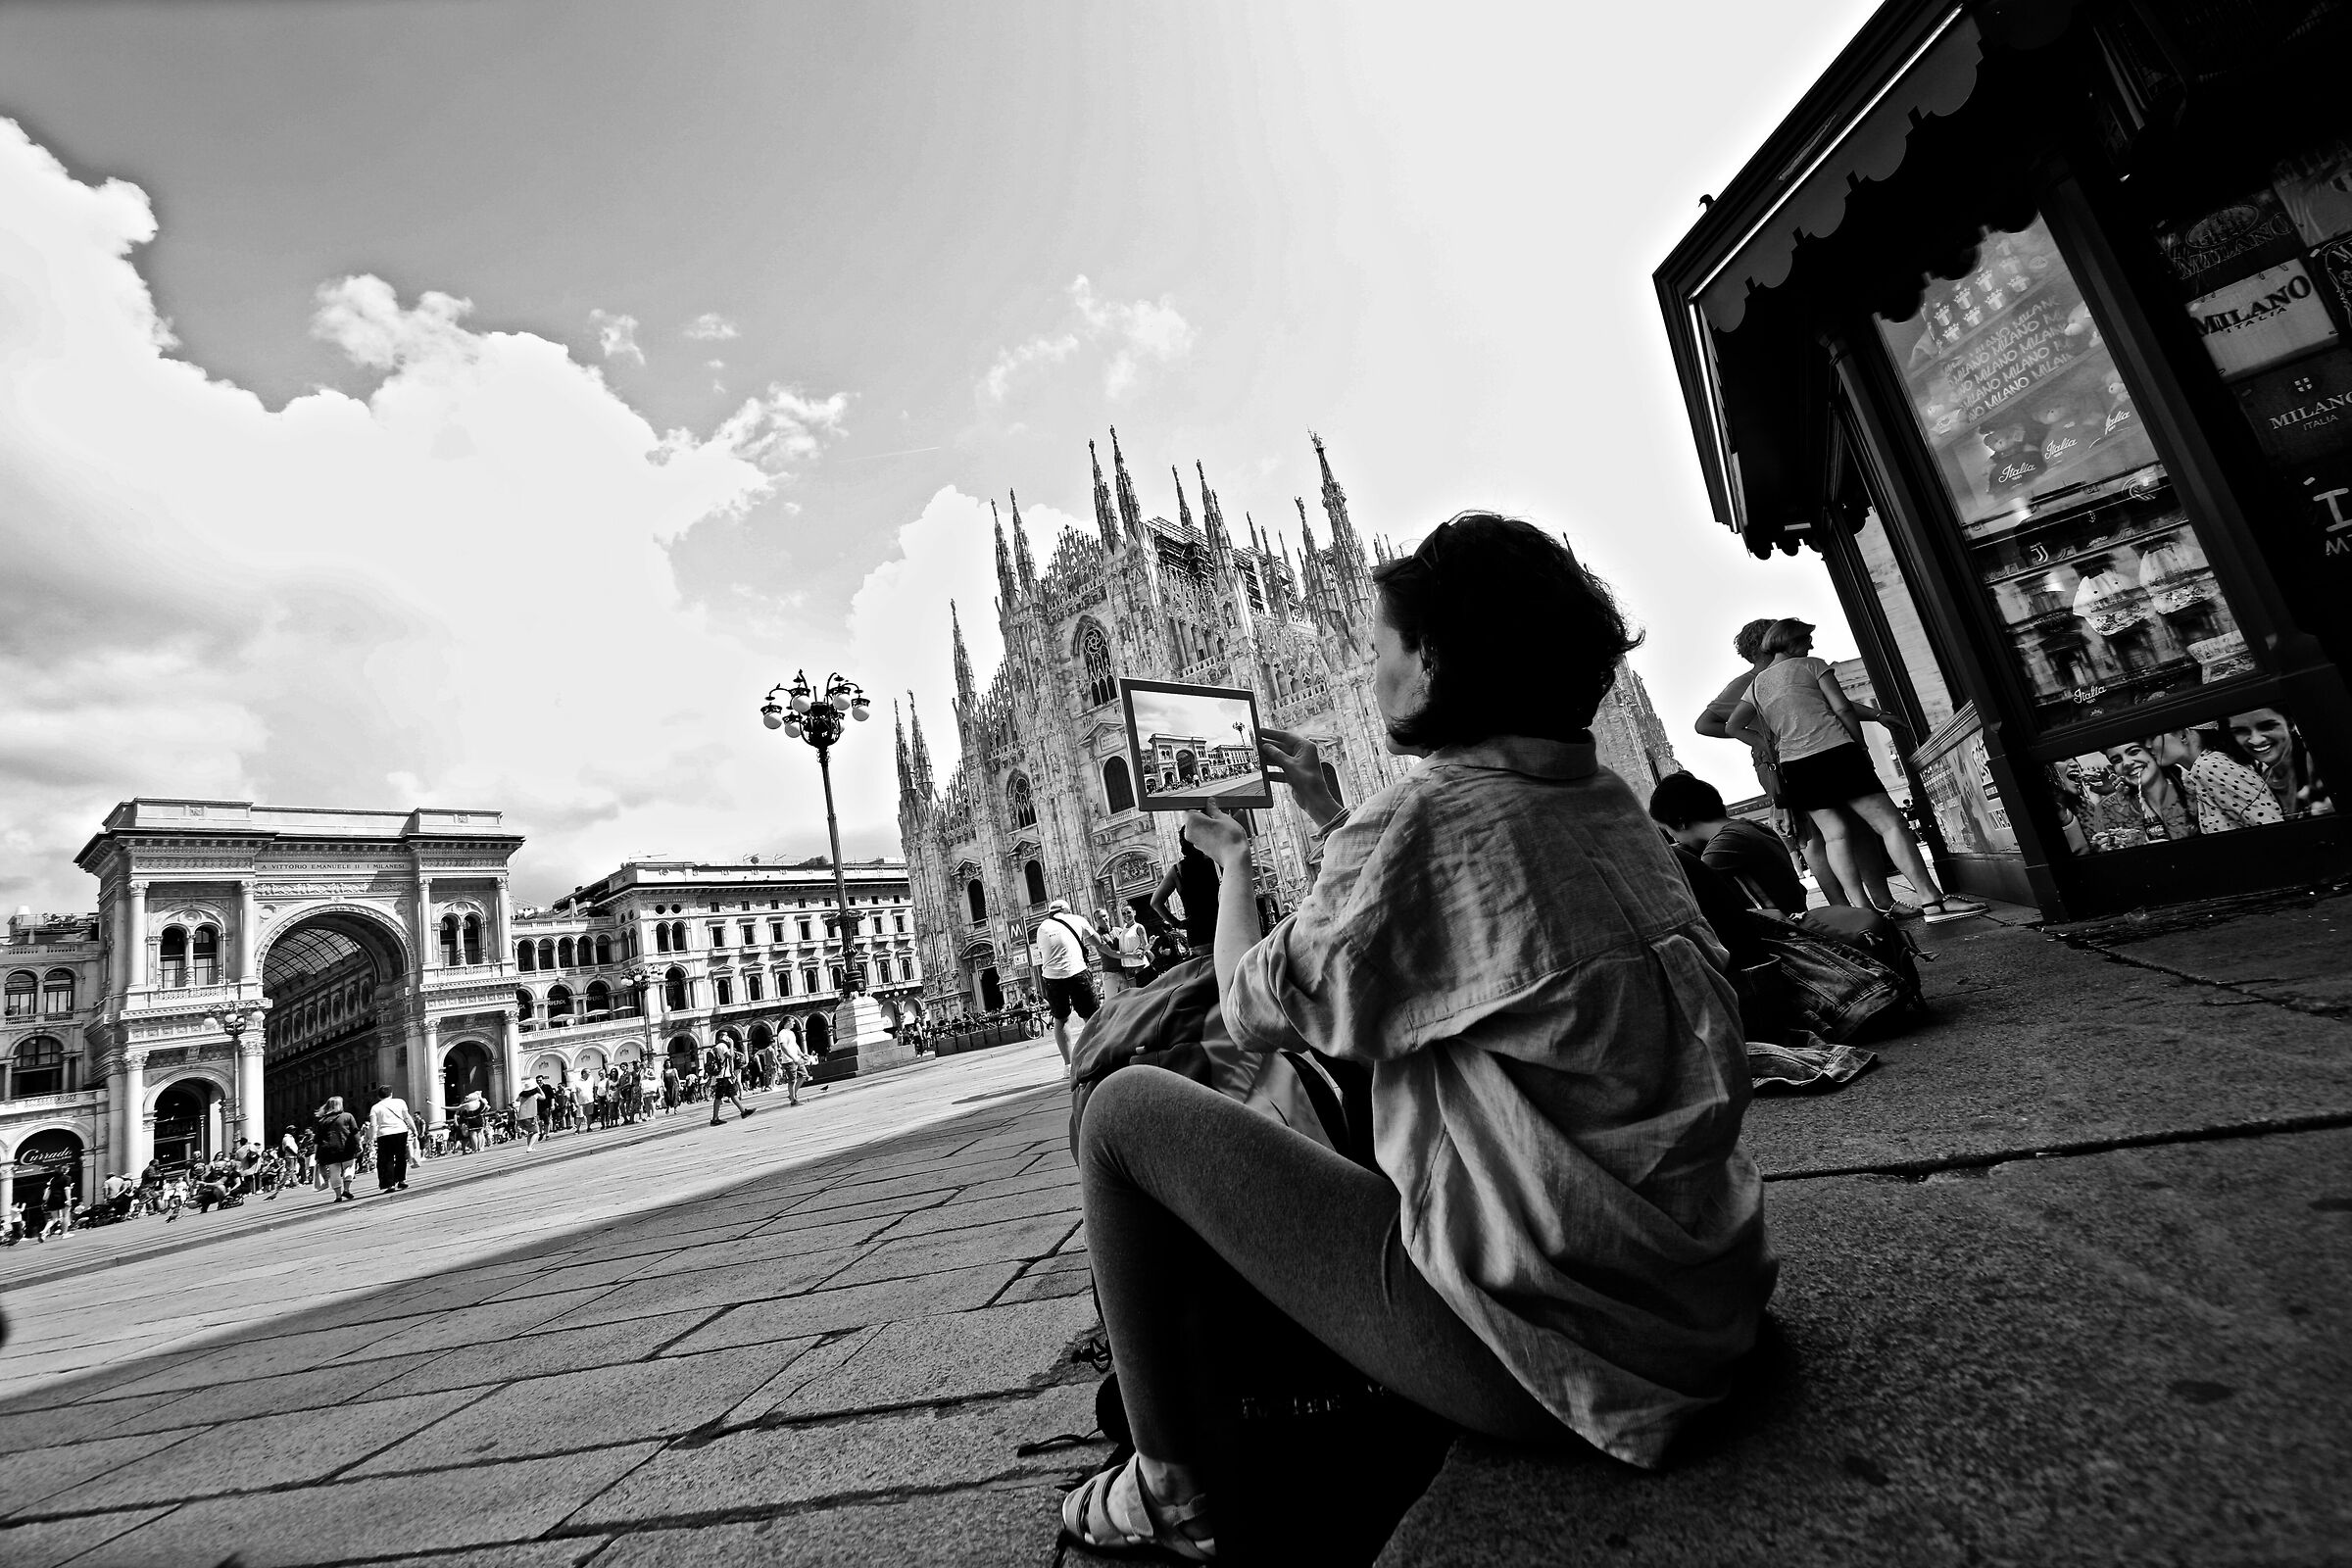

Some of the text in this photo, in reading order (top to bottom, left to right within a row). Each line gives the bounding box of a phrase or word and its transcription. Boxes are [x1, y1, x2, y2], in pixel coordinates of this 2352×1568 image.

[2189, 274, 2312, 337] MILANO
[2220, 306, 2287, 333] ITALIA
[1991, 319, 2040, 357] MILANO
[1974, 350, 2018, 384] MILANO
[2002, 347, 2049, 383] MILANO
[1984, 376, 2030, 410] MILANO
[2104, 408, 2132, 435] Italia
[2303, 414, 2339, 431] ITALIA
[2044, 437, 2078, 460] Italia
[1998, 461, 2036, 483] Italia
[2073, 684, 2108, 705] Italia
[1010, 924, 1023, 938] M
